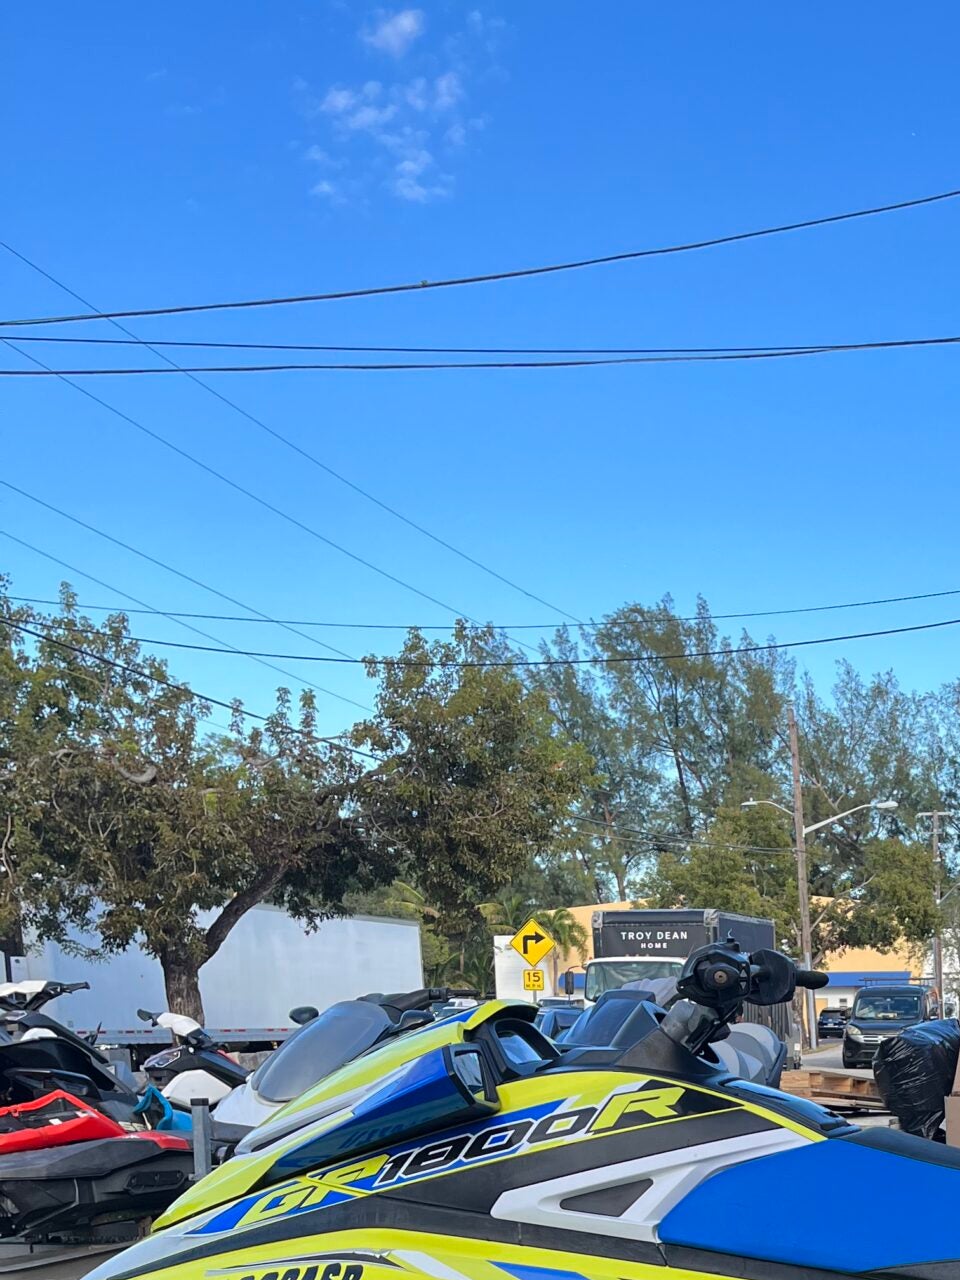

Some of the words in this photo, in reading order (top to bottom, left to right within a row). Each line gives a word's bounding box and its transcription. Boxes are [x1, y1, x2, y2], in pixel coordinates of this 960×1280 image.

[620, 931, 652, 940] TROY
[657, 931, 688, 940] DEAN
[526, 972, 541, 982] 15
